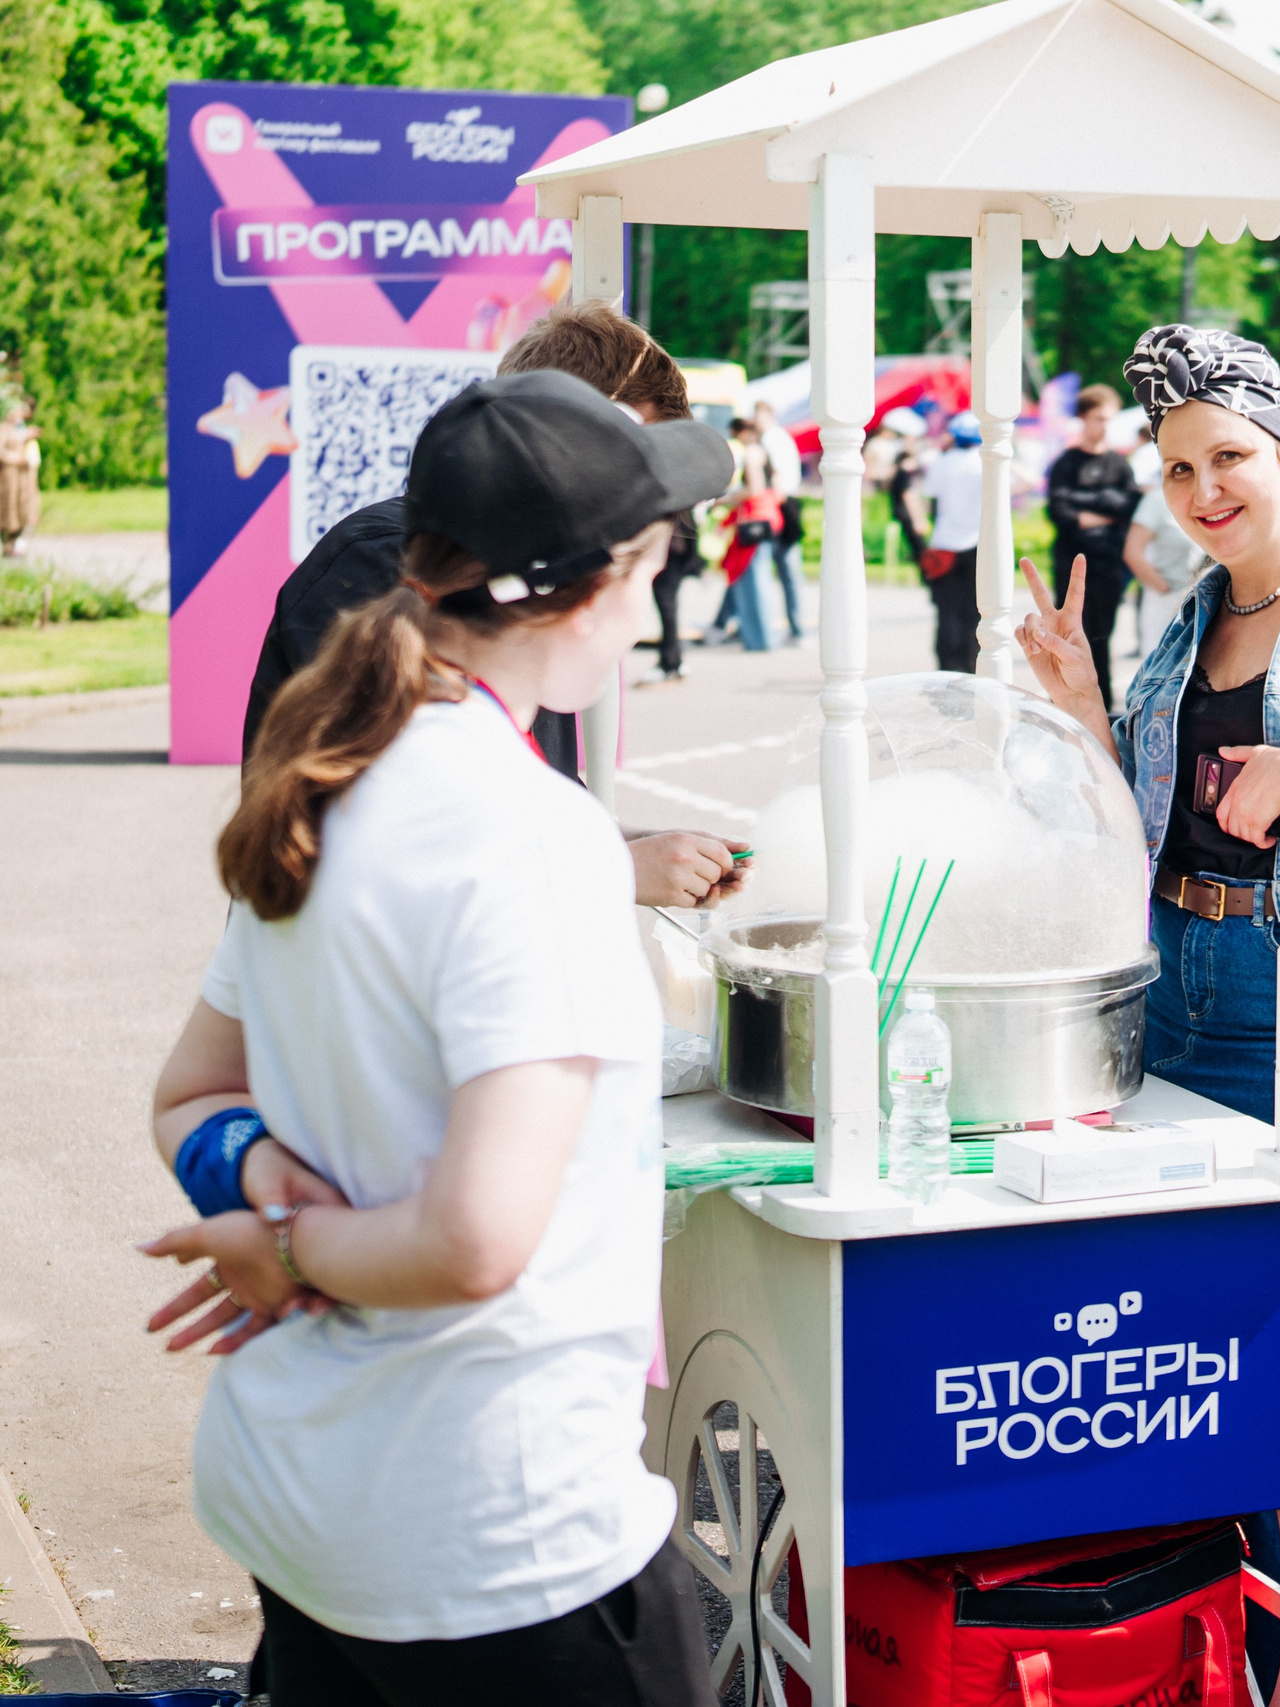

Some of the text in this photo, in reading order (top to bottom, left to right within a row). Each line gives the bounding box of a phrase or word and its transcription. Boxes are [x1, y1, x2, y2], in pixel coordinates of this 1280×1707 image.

[236, 217, 573, 262] ПРОГРАММА
[935, 1337, 1240, 1415] БЛОГЕРЫ
[956, 1391, 1220, 1466] РОССИИ
